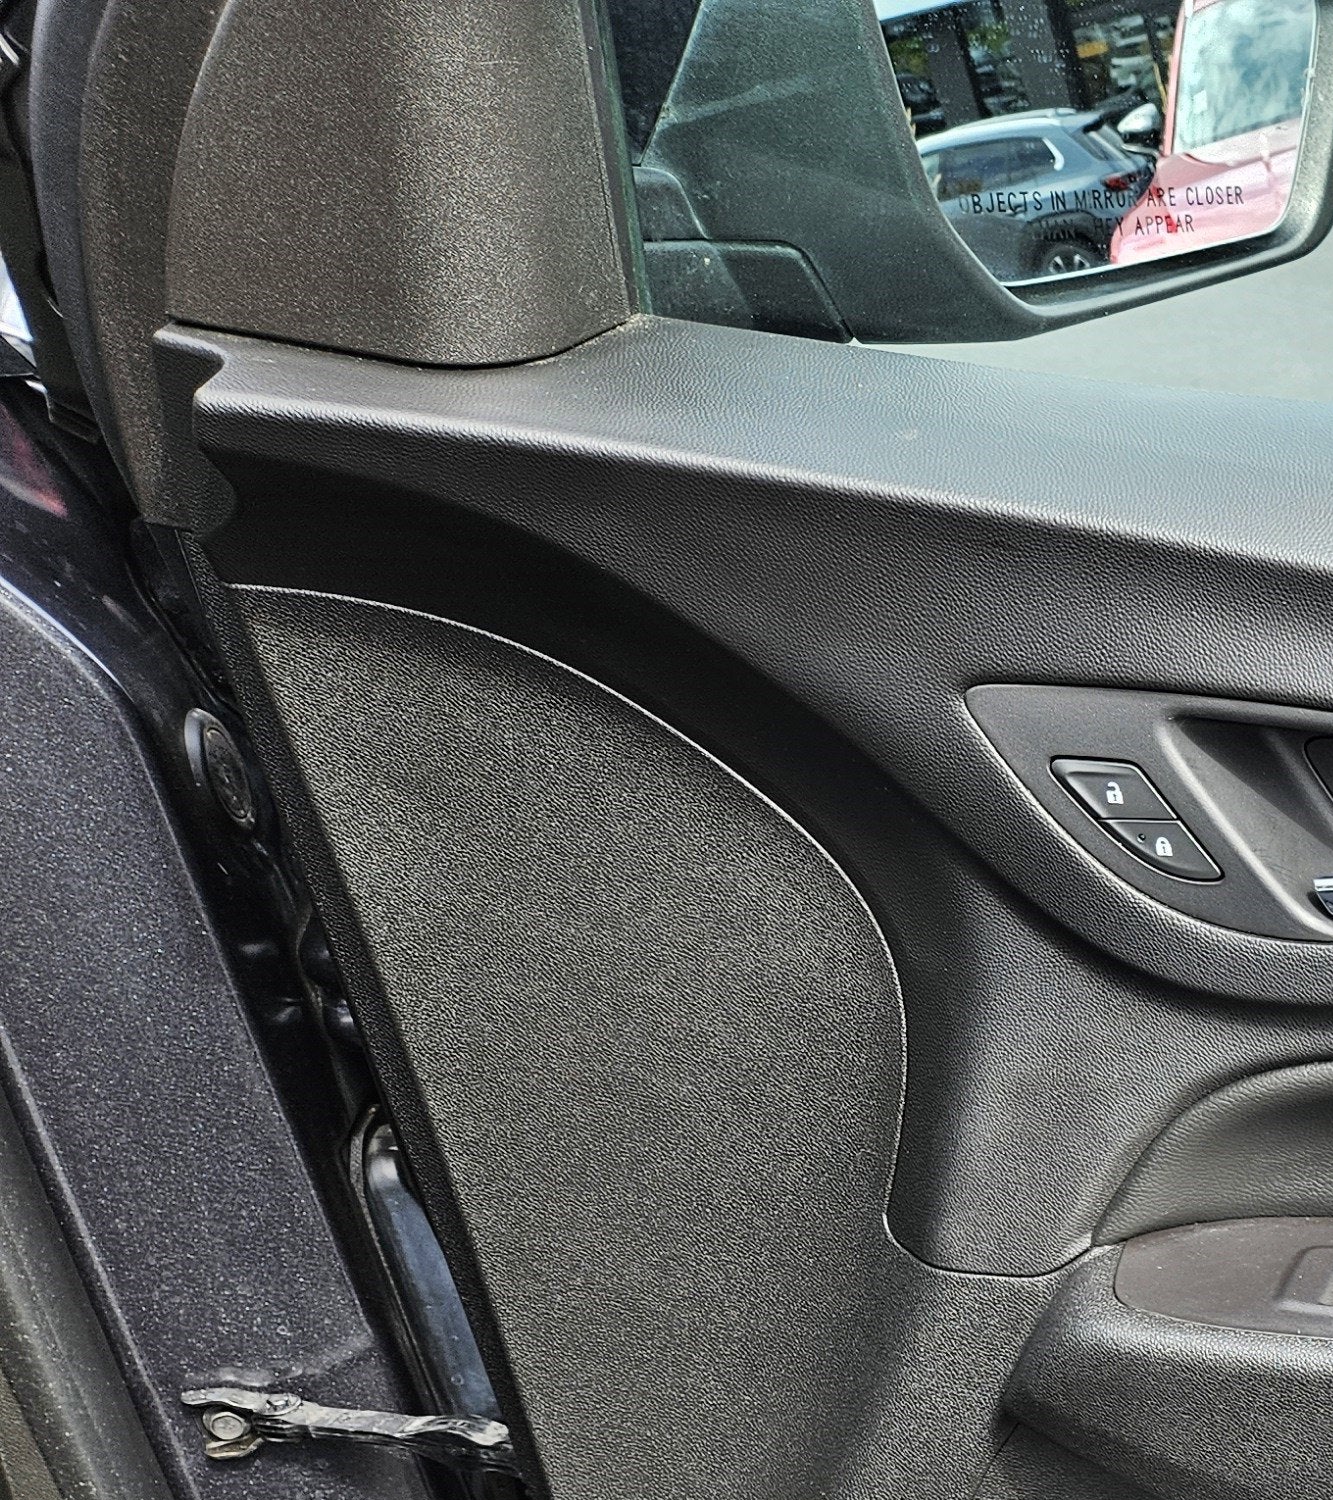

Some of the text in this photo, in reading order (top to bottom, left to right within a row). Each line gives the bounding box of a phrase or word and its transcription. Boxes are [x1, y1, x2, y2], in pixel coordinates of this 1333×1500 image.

[958, 185, 1245, 215] OBJECTS IN MIRROR ARE CLOSER
[1030, 214, 1196, 240] HAN HEY APPEAR
